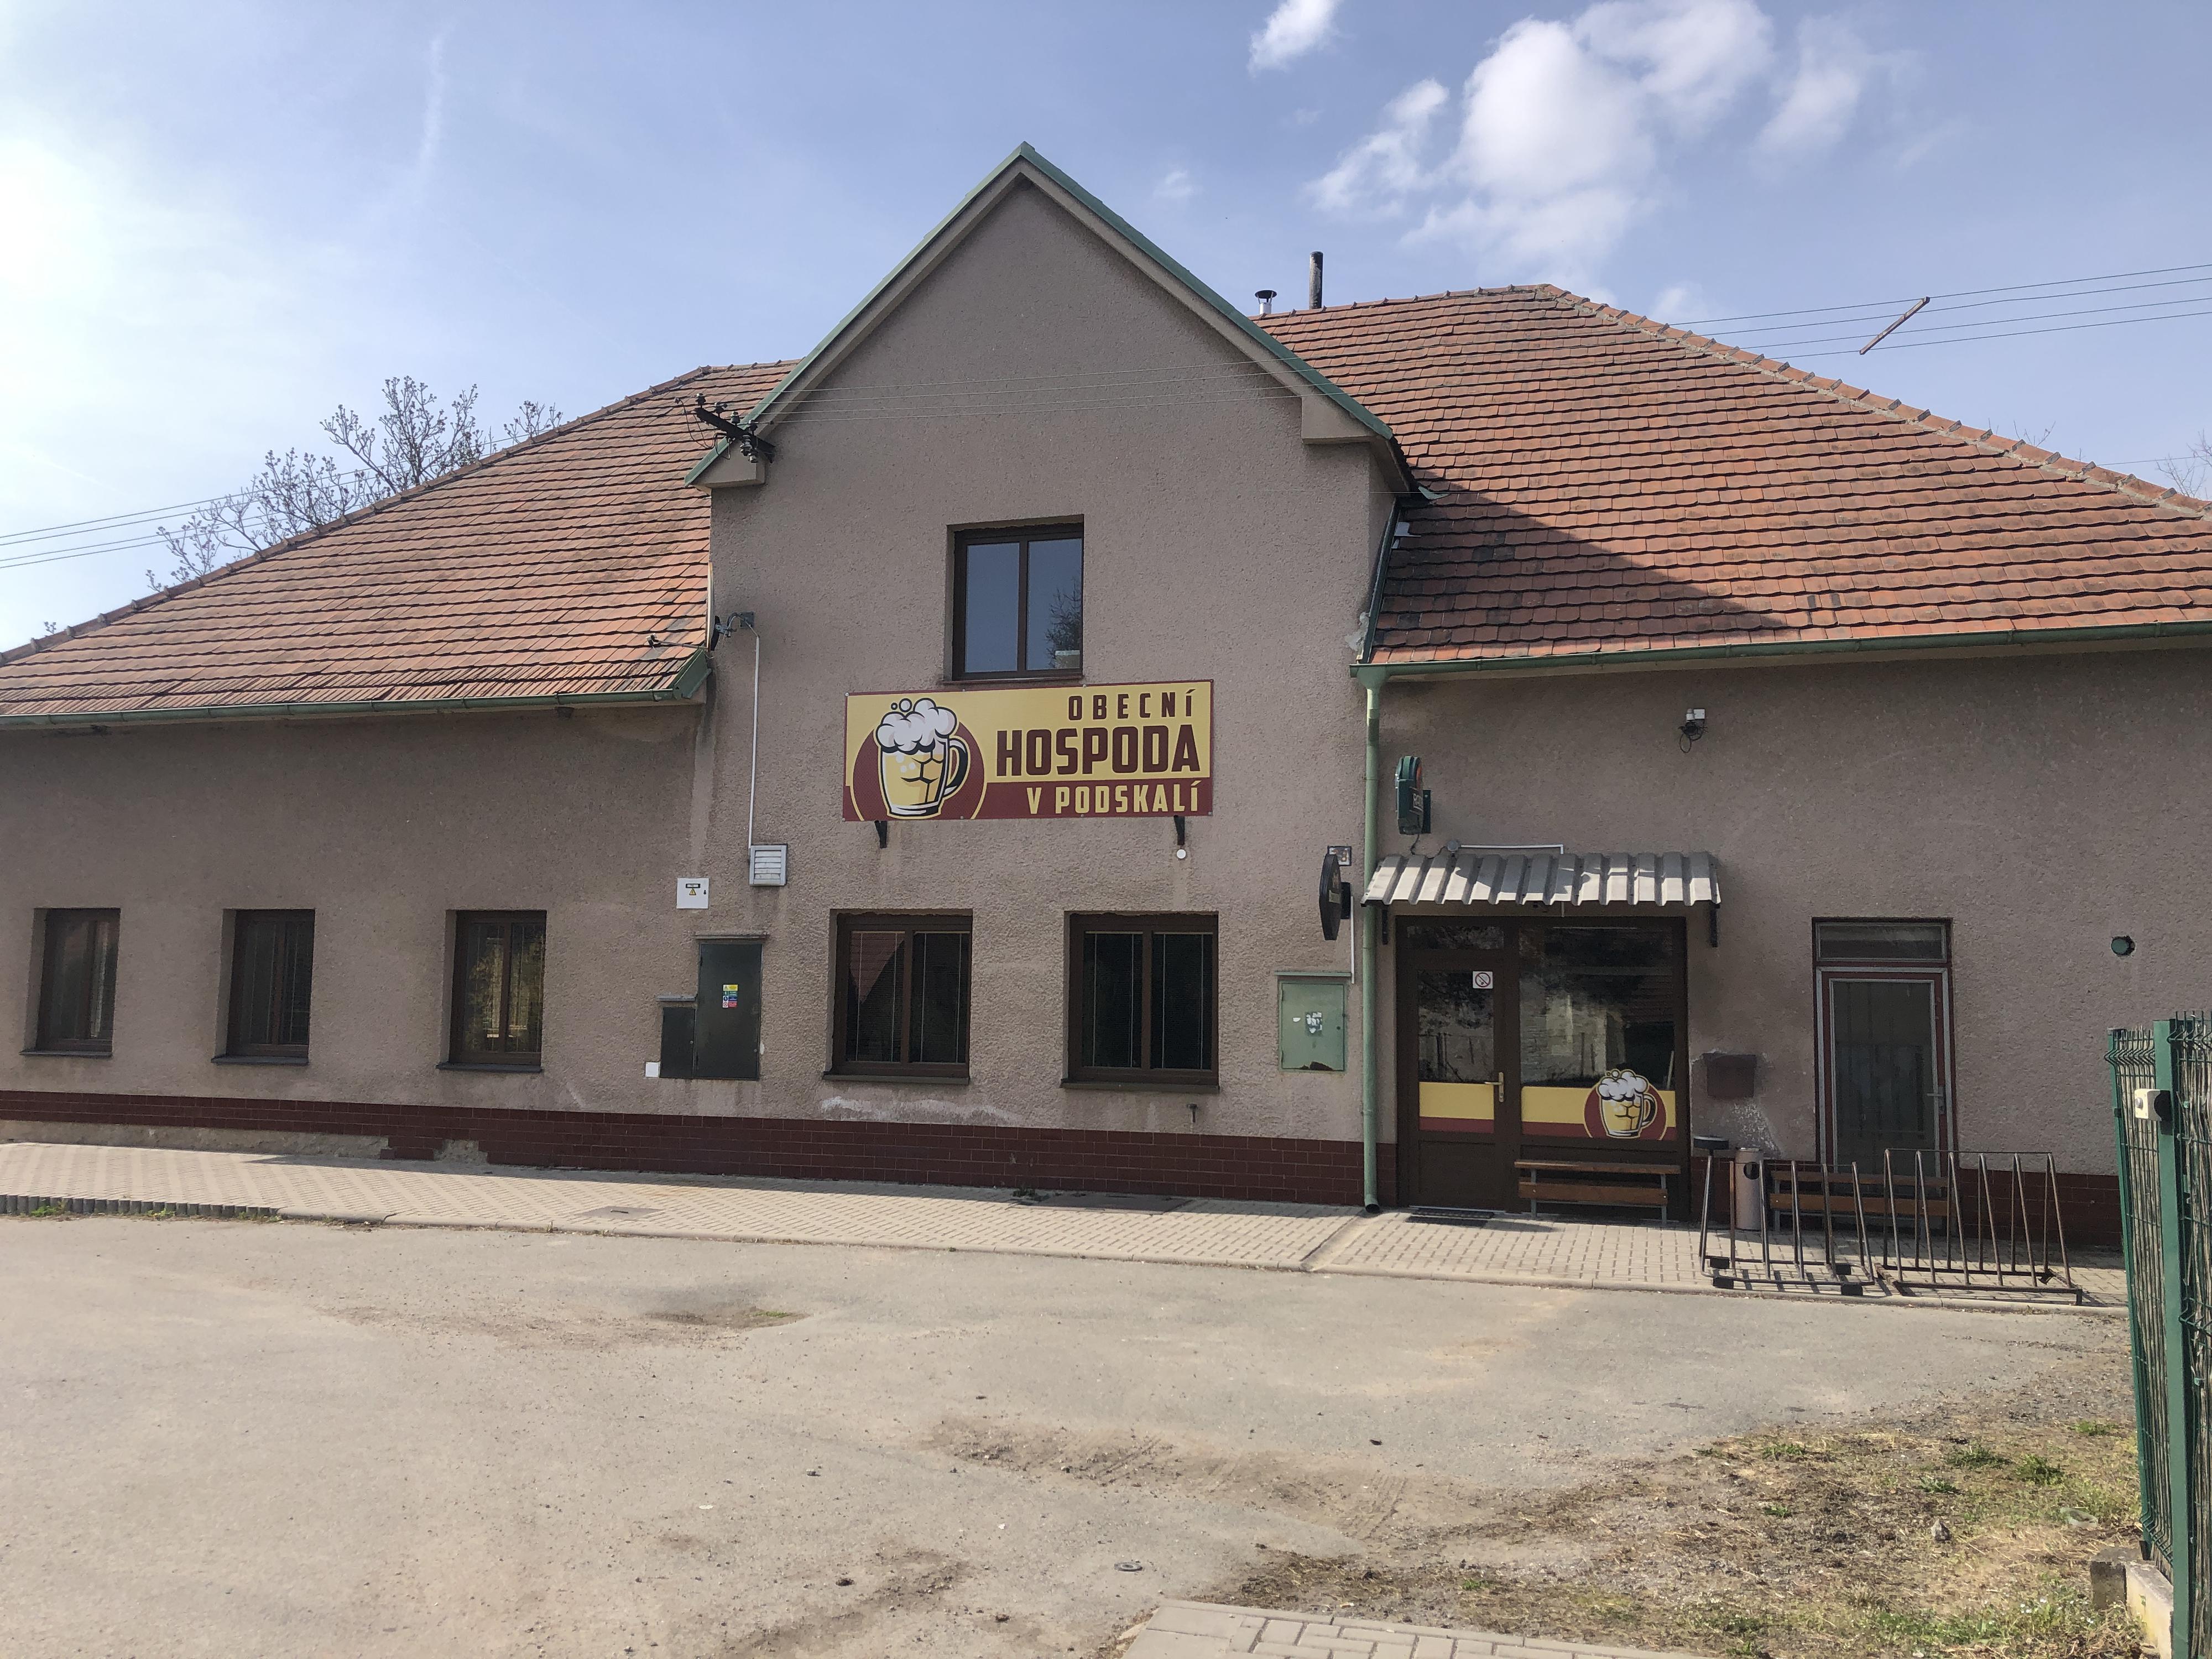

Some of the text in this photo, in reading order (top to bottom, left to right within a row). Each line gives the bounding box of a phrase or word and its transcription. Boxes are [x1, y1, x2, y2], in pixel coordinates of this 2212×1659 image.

[1068, 688, 1196, 721] OBECNÍ
[997, 724, 1201, 776] HOSPODA
[1026, 780, 1202, 814] V PODSKALÍ
